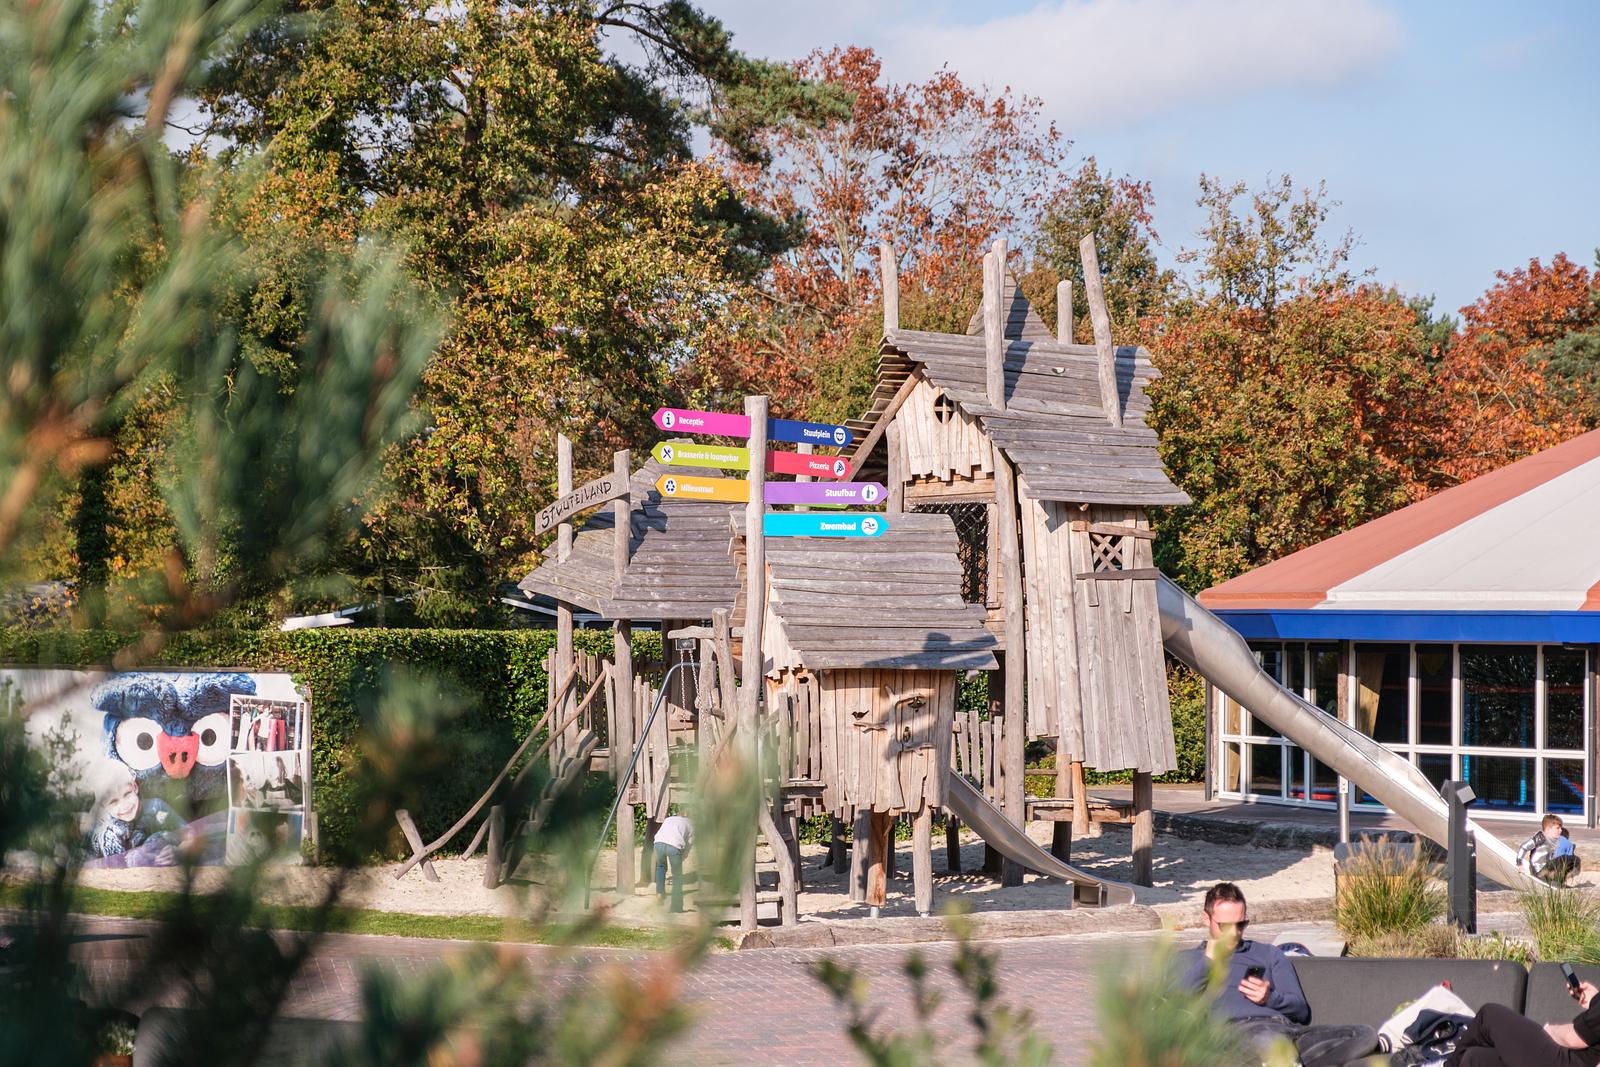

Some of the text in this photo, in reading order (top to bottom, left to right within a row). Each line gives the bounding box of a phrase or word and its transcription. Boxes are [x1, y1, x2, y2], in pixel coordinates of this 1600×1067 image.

[678, 416, 705, 427] Receptie
[809, 461, 830, 470] Pizzeria
[825, 488, 857, 497] Stuufbar
[820, 521, 857, 531] Zwembad
